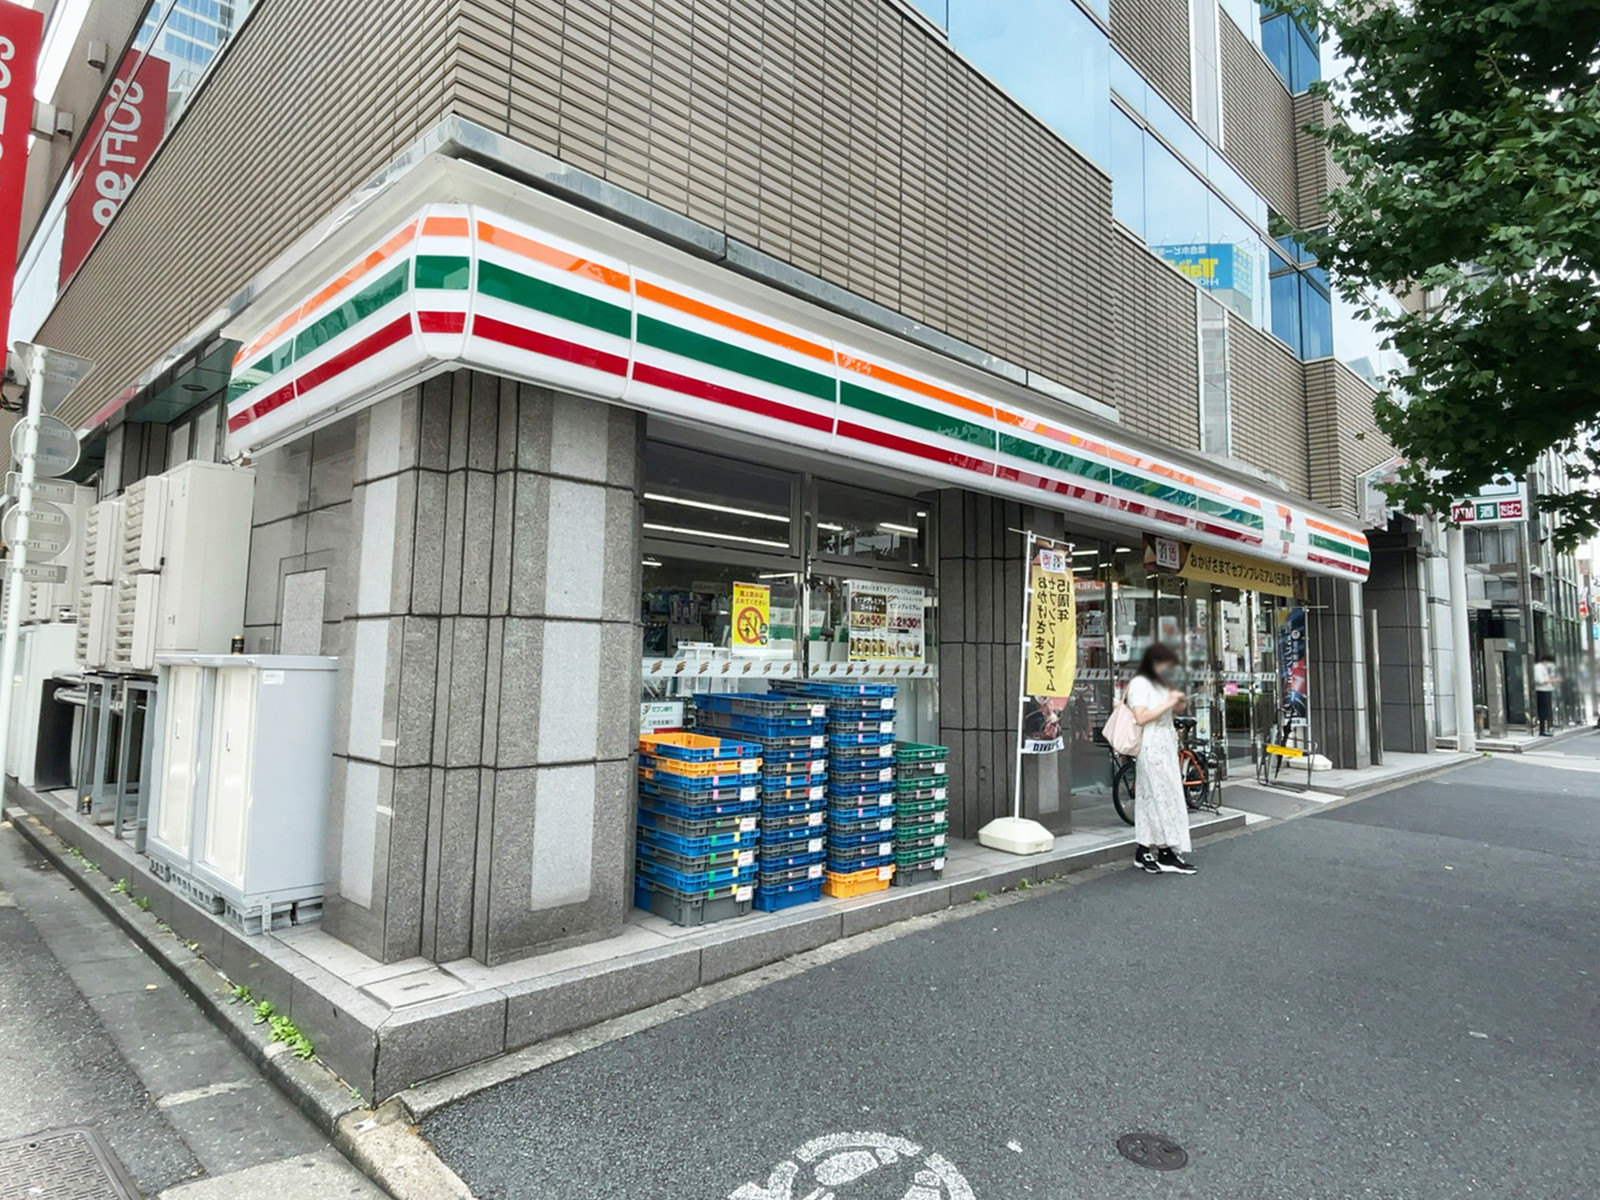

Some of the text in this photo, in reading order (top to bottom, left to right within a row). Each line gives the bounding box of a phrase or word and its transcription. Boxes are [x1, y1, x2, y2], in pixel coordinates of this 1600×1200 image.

[1479, 504, 1494, 519] 酒
[1500, 503, 1521, 517] たばこ
